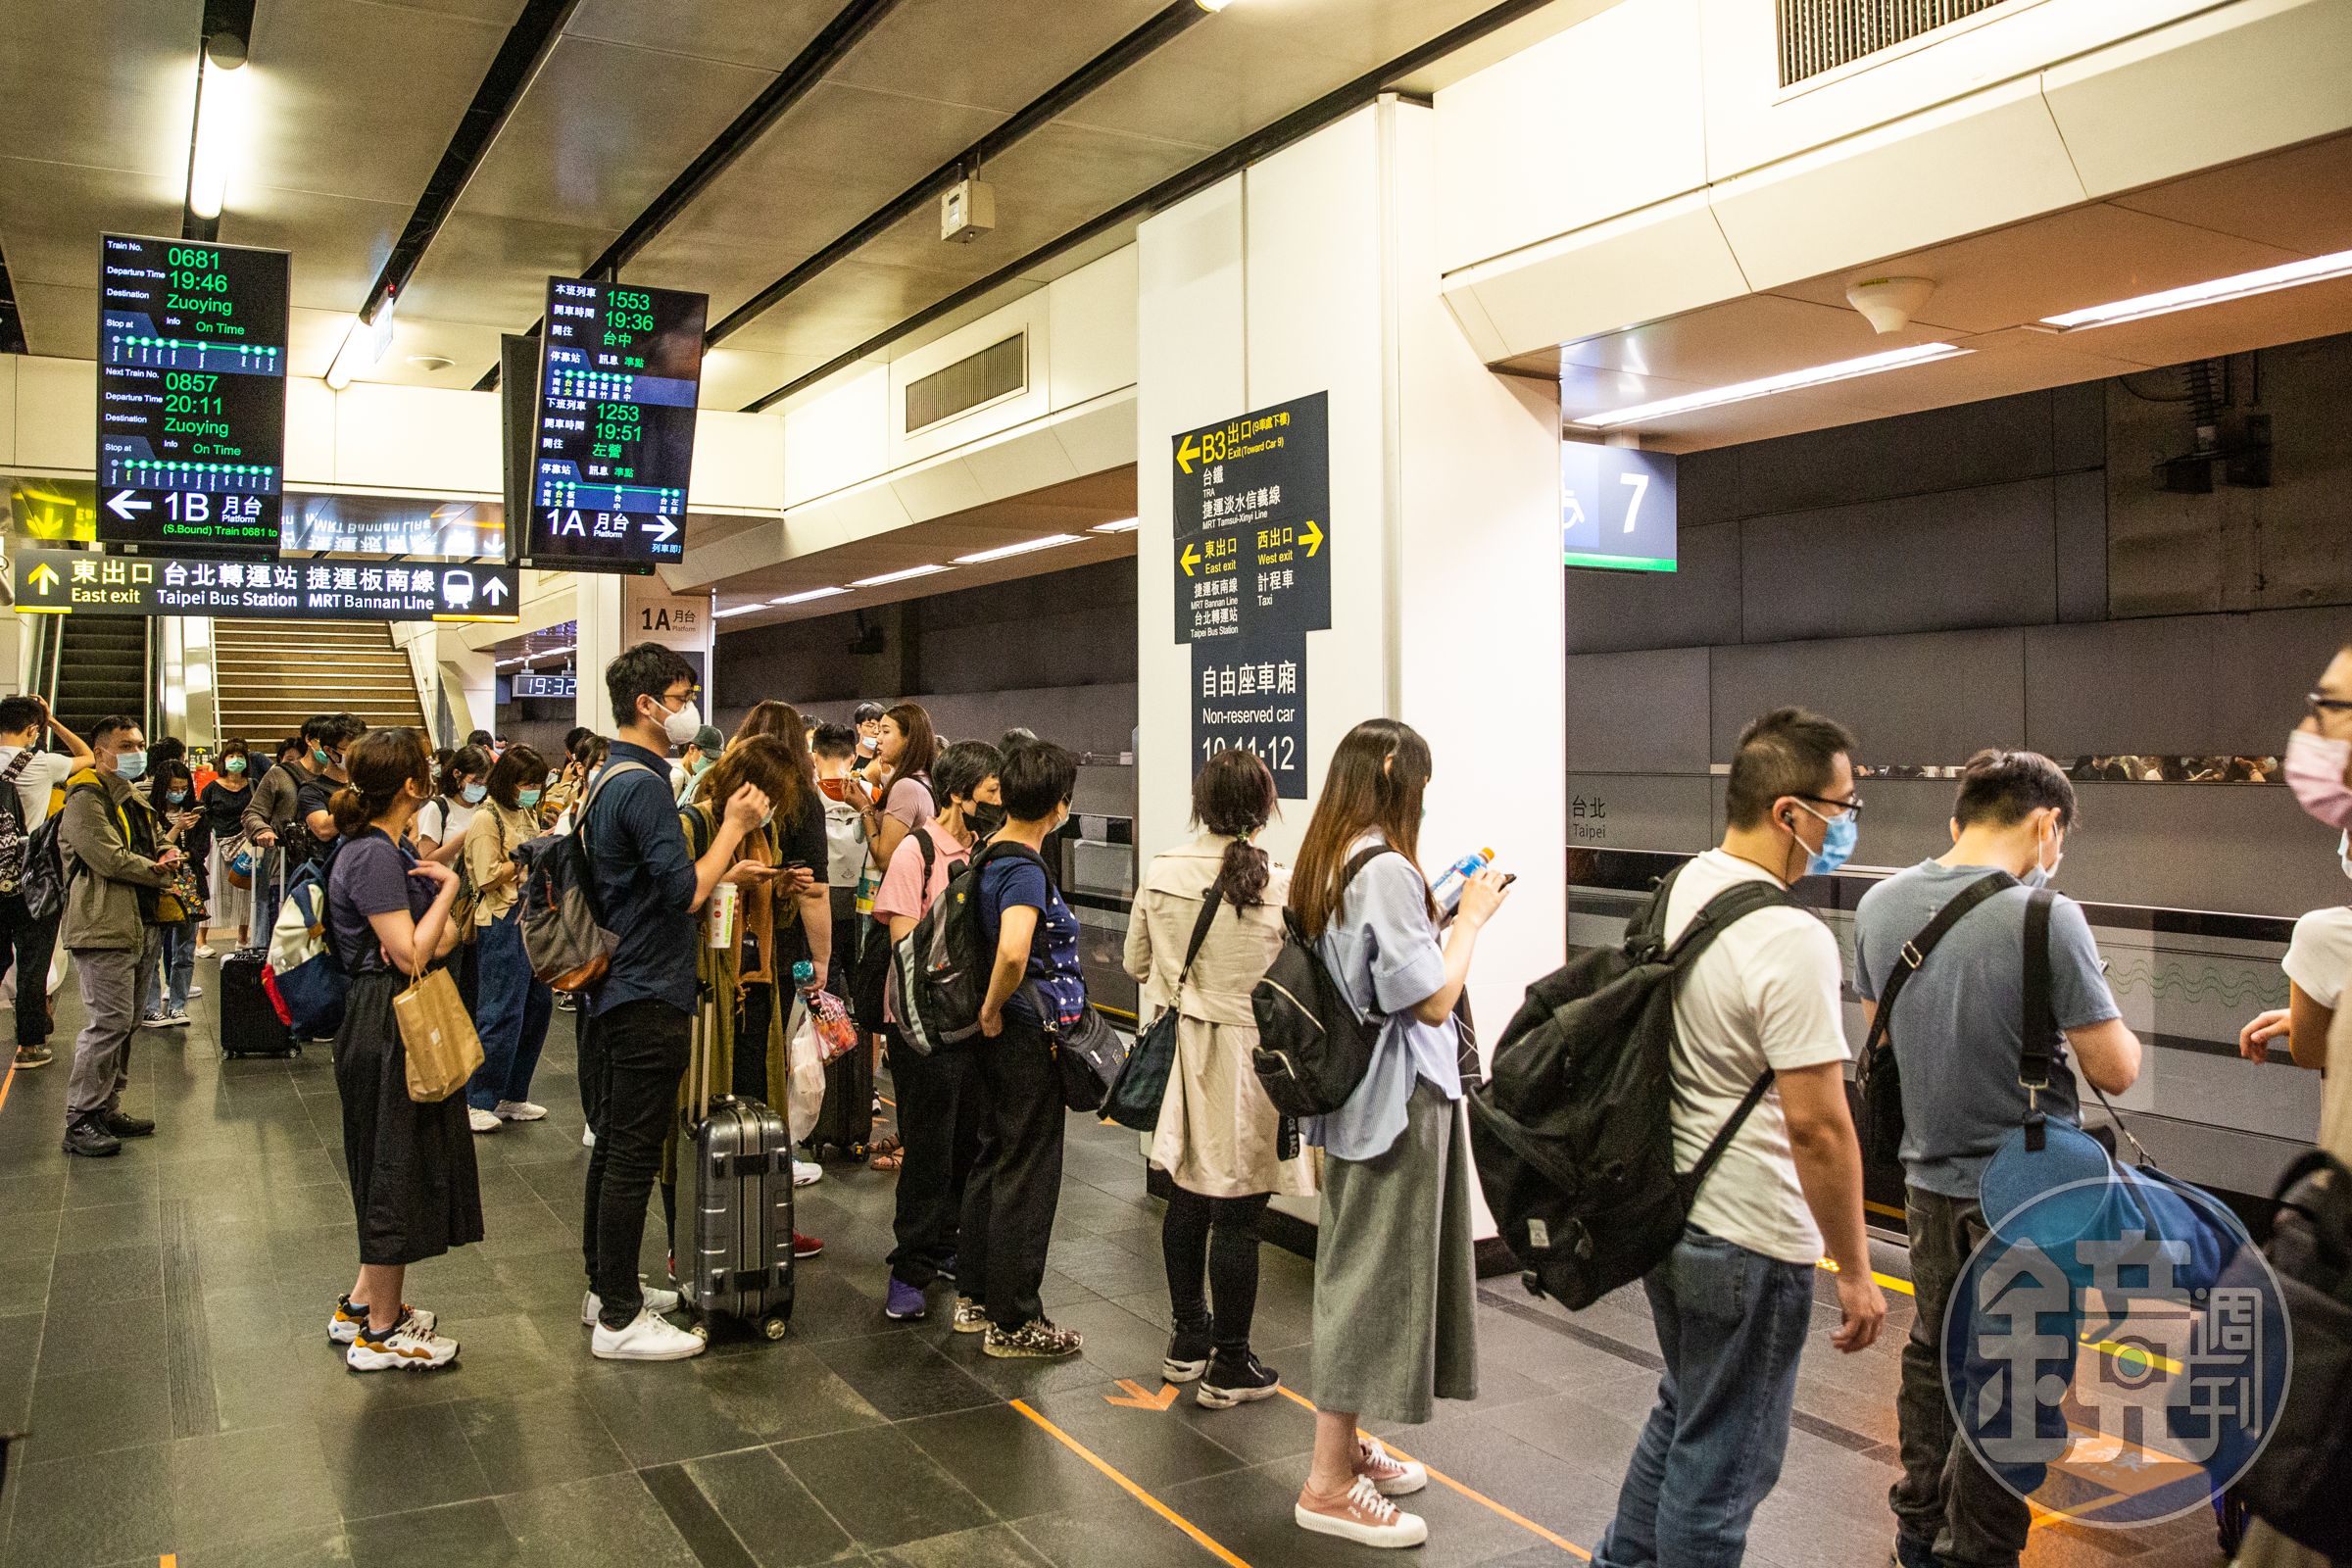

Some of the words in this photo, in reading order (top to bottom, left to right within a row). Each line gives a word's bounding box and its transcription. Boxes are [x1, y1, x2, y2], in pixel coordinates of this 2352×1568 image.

[107, 241, 127, 250] Train
[169, 247, 220, 270] 0681
[107, 267, 145, 277] Departure
[147, 270, 166, 279] Time
[170, 270, 228, 293] 19:46
[107, 288, 149, 299] Destination
[556, 284, 597, 299] 本班列車
[167, 294, 232, 316] Zuoying
[607, 290, 650, 311] 1553
[553, 305, 595, 319] 開車時間
[106, 318, 123, 329] Stop
[167, 317, 181, 325] Info
[196, 321, 213, 332] On
[217, 323, 245, 335] Time
[605, 311, 654, 331] 19:36
[552, 325, 573, 337] 開往
[603, 331, 632, 348] 台中
[550, 351, 581, 365] 停靠站
[598, 354, 618, 366] 訊息
[106, 368, 123, 376] Next
[125, 368, 144, 378] Train
[146, 370, 160, 379] No.
[166, 372, 219, 393] 0857
[106, 393, 143, 403] Departure
[144, 394, 164, 404] Time
[165, 394, 222, 415] 20:11
[546, 397, 587, 412] 下班列車
[105, 414, 147, 423] Destination
[597, 403, 640, 422] 1253
[164, 417, 229, 438] Zuoying
[544, 418, 585, 431] 開車時間
[595, 422, 642, 442] 19:51
[1227, 420, 1251, 446] 出口
[105, 443, 122, 453] Stop
[193, 443, 211, 455] On
[213, 445, 242, 456] Time
[542, 438, 564, 450] 開往
[592, 443, 622, 460] 左營
[1202, 430, 1226, 465] B3
[1265, 439, 1277, 450] Car
[541, 463, 571, 475] 停靠站
[588, 465, 609, 476] 訊息
[1202, 465, 1224, 487] 台鐵
[1202, 485, 1281, 519] 捷運淡水信義線
[1203, 488, 1215, 499] TRA
[165, 491, 210, 522] 1B
[221, 495, 263, 516] 月台
[1620, 472, 1649, 534] 7
[221, 514, 256, 523] Platform
[546, 509, 586, 537] 1A
[594, 513, 630, 531] 月台
[1202, 519, 1217, 530] MRT
[1254, 509, 1268, 519] Line
[163, 523, 213, 536] (S.Bound)
[215, 526, 240, 536] Train
[242, 528, 267, 537] 0681
[269, 529, 278, 538] to
[593, 529, 623, 539] Platform
[1257, 526, 1293, 550] 西出口
[652, 543, 681, 554] 列車即
[1204, 537, 1237, 560] 東出口
[1257, 554, 1278, 565] West
[1279, 550, 1294, 563] exit
[71, 560, 153, 585] 東出口
[1205, 563, 1221, 574] East
[1223, 560, 1237, 571] exit
[164, 562, 298, 590] 台北轉運站
[306, 566, 435, 593] 捷運板南線
[1257, 568, 1294, 593] 計程車
[72, 588, 107, 604] East
[111, 589, 141, 604] exit
[1194, 577, 1238, 599] 捷運板南線
[157, 590, 205, 608] Taipei
[210, 591, 239, 606] Bus
[243, 592, 298, 608] Station
[308, 594, 341, 609] MRT
[344, 595, 401, 610] Bannan
[404, 595, 435, 611] Line
[1191, 600, 1203, 611] MRT
[1204, 598, 1225, 609] Bannan
[1226, 596, 1239, 606] Line
[1257, 594, 1273, 607] Taxi
[641, 608, 671, 631] 1A
[672, 610, 696, 623] 月台
[1195, 607, 1238, 626] 台北轉運站
[672, 624, 697, 633] Platform
[1191, 628, 1207, 639] Taipei
[1207, 627, 1219, 636] Bus
[1219, 625, 1239, 635] Station
[528, 677, 577, 696] 19:32
[1202, 660, 1297, 698] 自由座車廂
[1202, 705, 1274, 724] Non-reserved
[1276, 708, 1296, 723] car
[1572, 795, 1606, 818] 台北
[1573, 823, 1606, 841] Taipei
